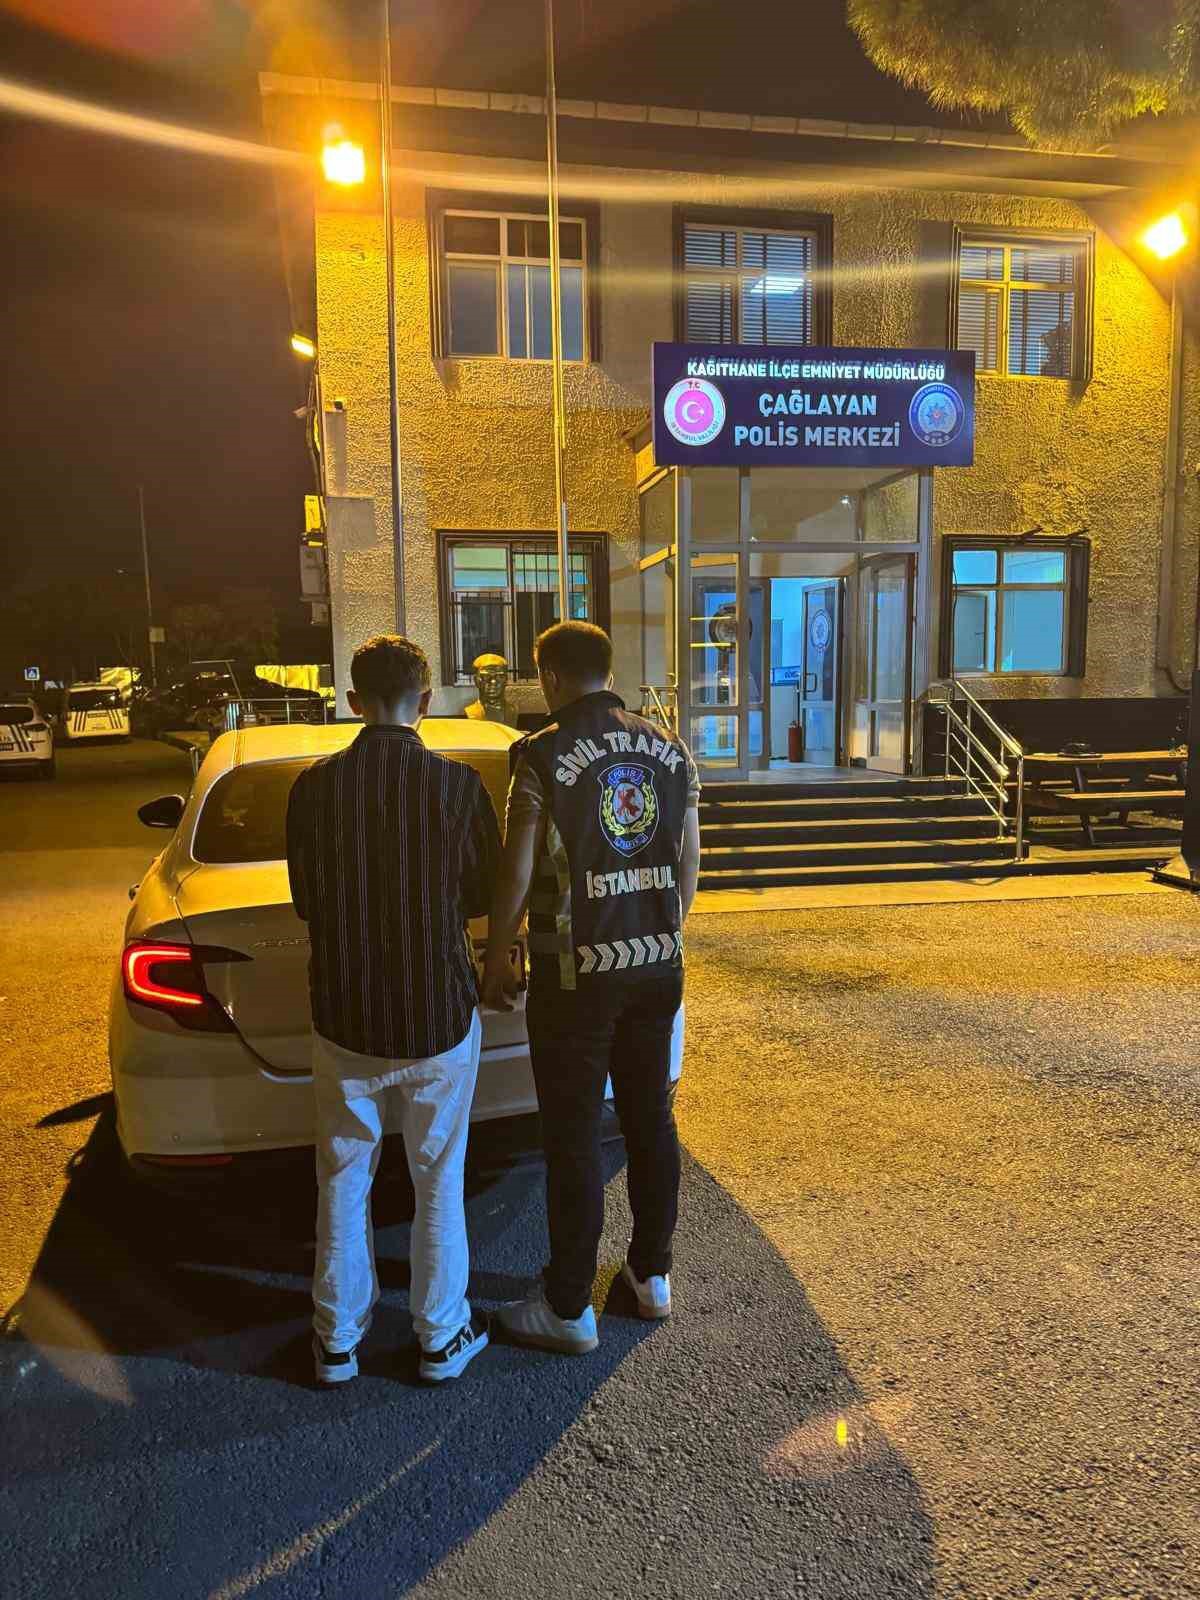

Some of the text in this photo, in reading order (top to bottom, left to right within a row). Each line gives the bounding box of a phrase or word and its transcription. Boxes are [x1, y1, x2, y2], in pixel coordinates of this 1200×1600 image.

[687, 360, 945, 381] KAĞITHANE İLÇE EMNİYET MÜDÜRLÜĞÜ
[758, 389, 877, 417] ÇAĞLAYAN
[734, 421, 799, 446] POLİS
[804, 421, 900, 447] MERKEZİ
[555, 738, 608, 787] SİVİL
[585, 865, 676, 899] İSTANBUL
